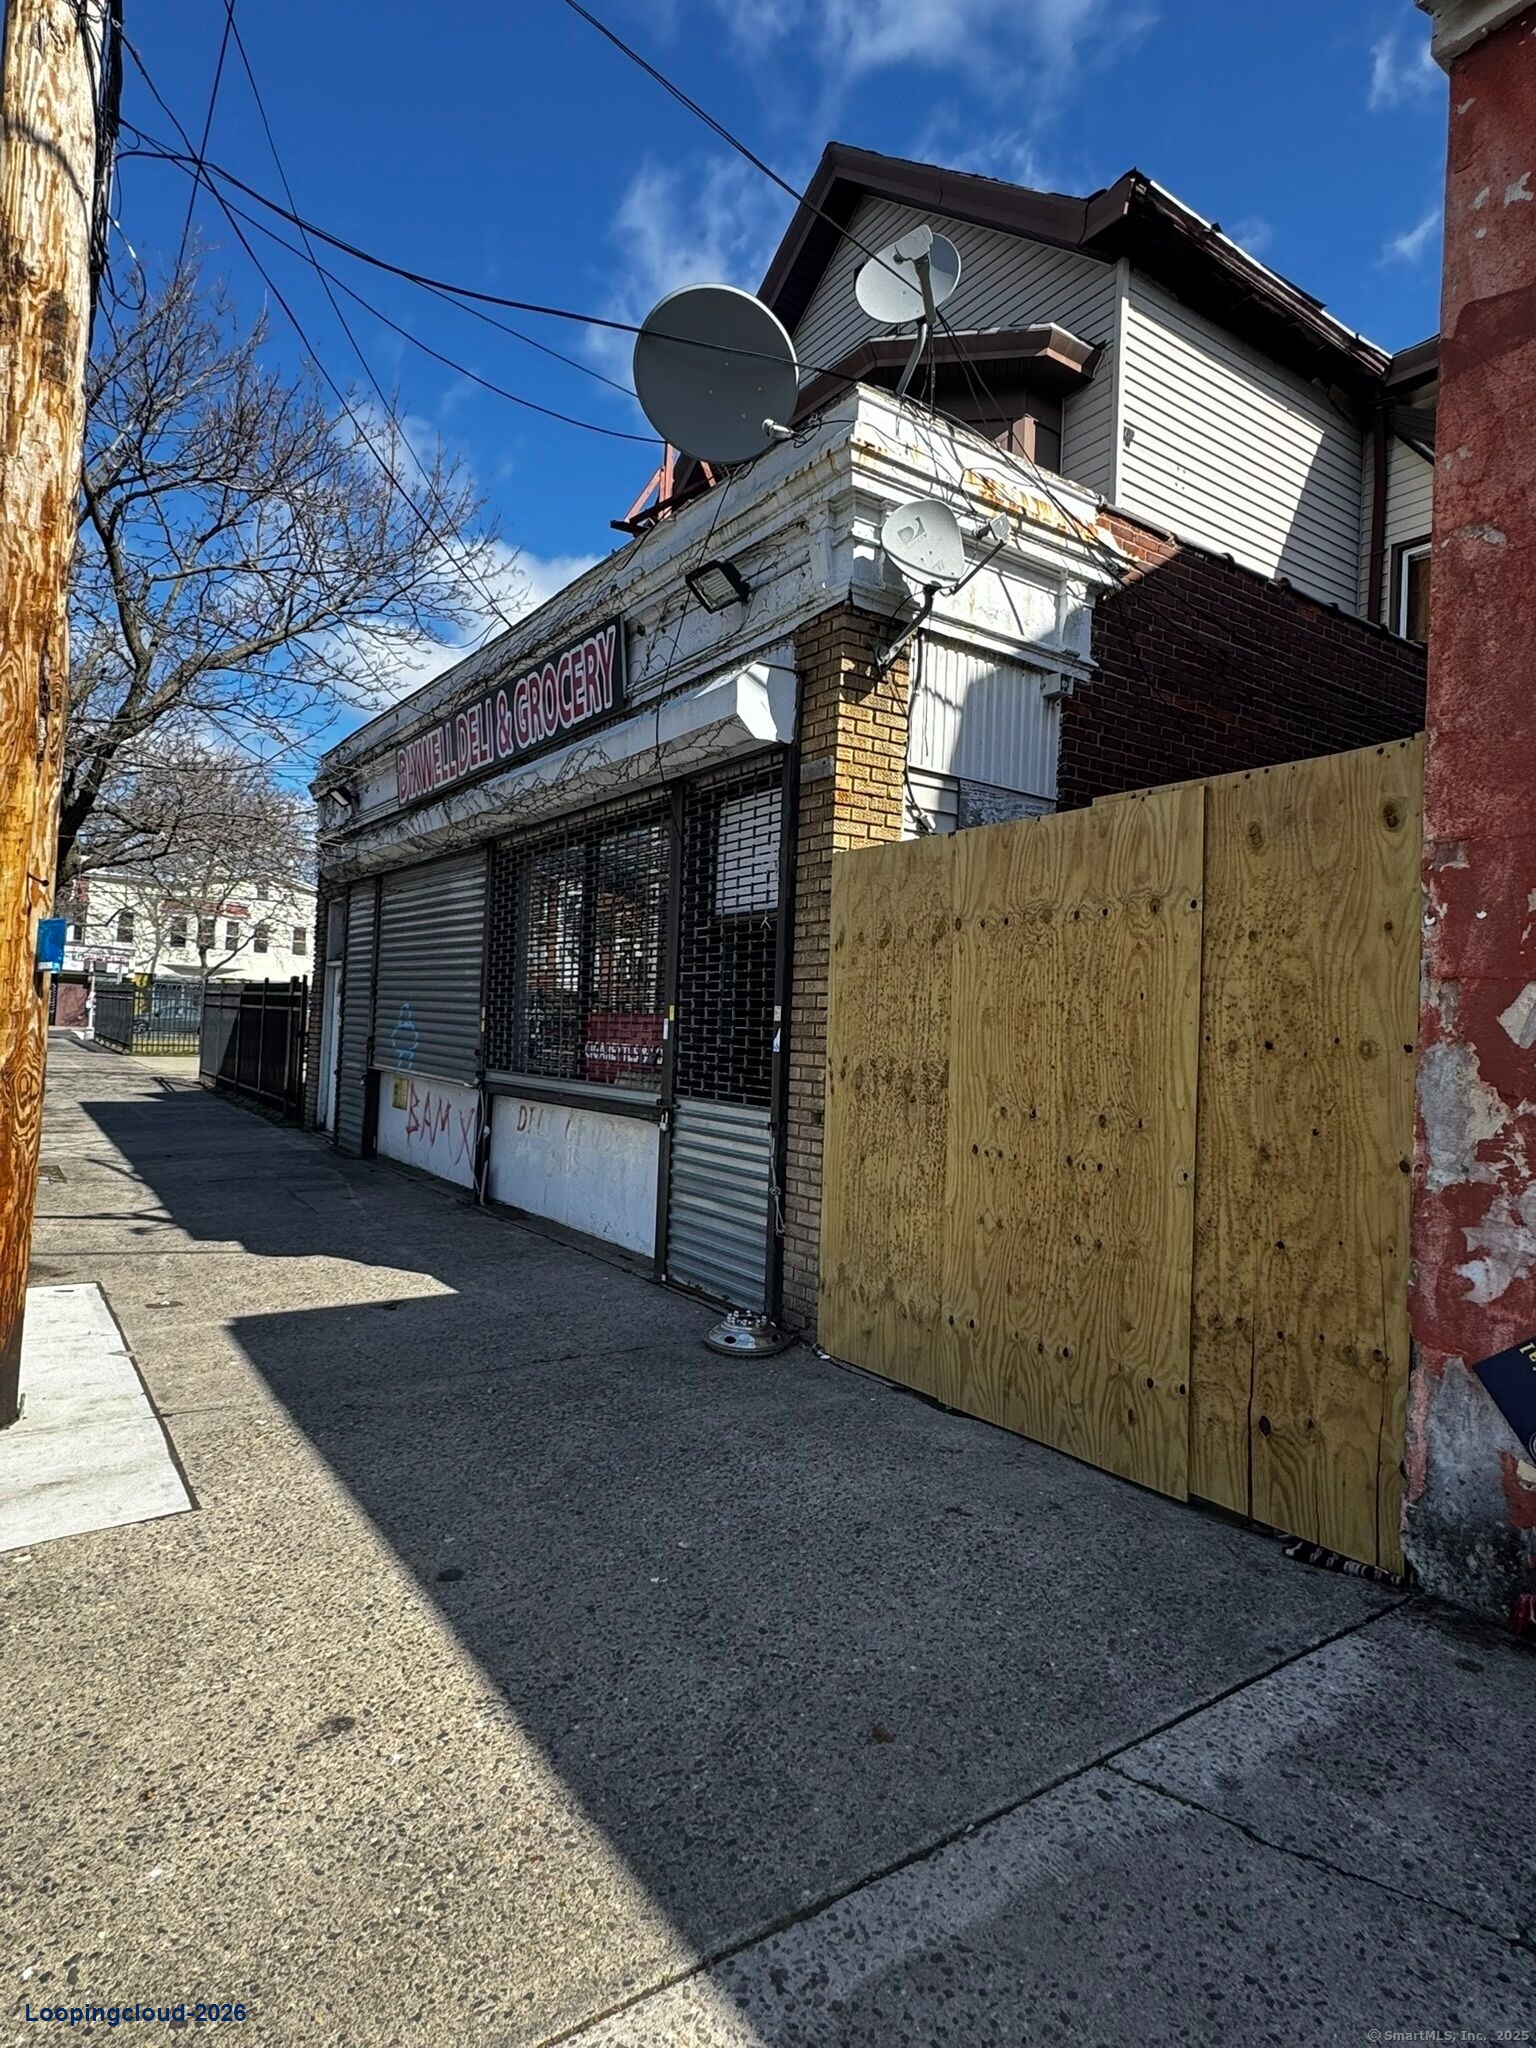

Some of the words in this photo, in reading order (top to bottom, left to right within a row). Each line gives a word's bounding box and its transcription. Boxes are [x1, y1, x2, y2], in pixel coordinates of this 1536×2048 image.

[455, 697, 494, 777] DELI
[496, 689, 514, 758] &
[514, 624, 616, 750] GROCERY
